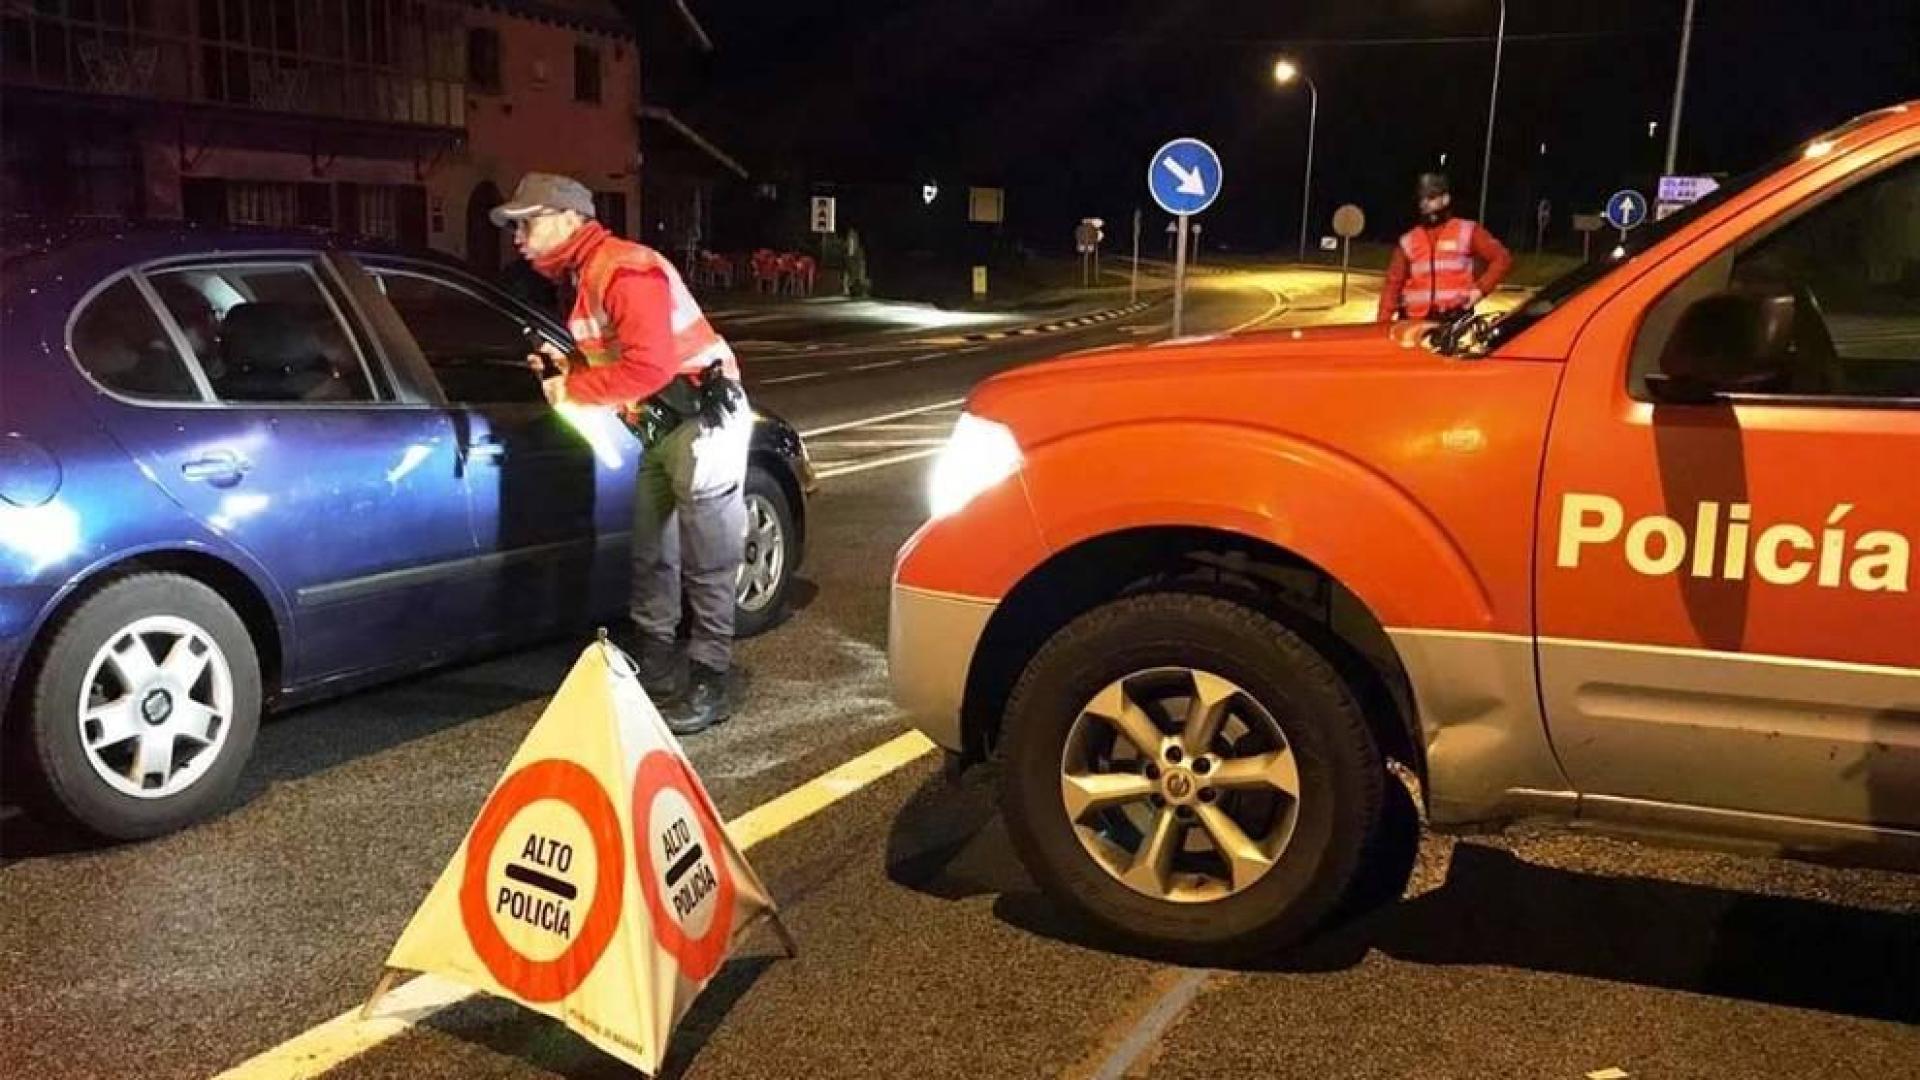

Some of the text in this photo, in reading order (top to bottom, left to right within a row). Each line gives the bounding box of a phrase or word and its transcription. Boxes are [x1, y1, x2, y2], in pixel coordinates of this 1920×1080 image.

[1556, 492, 1910, 593] Policía
[521, 833, 573, 873] ALTO
[662, 818, 691, 861] ALTO
[496, 887, 571, 940] POLICÍA
